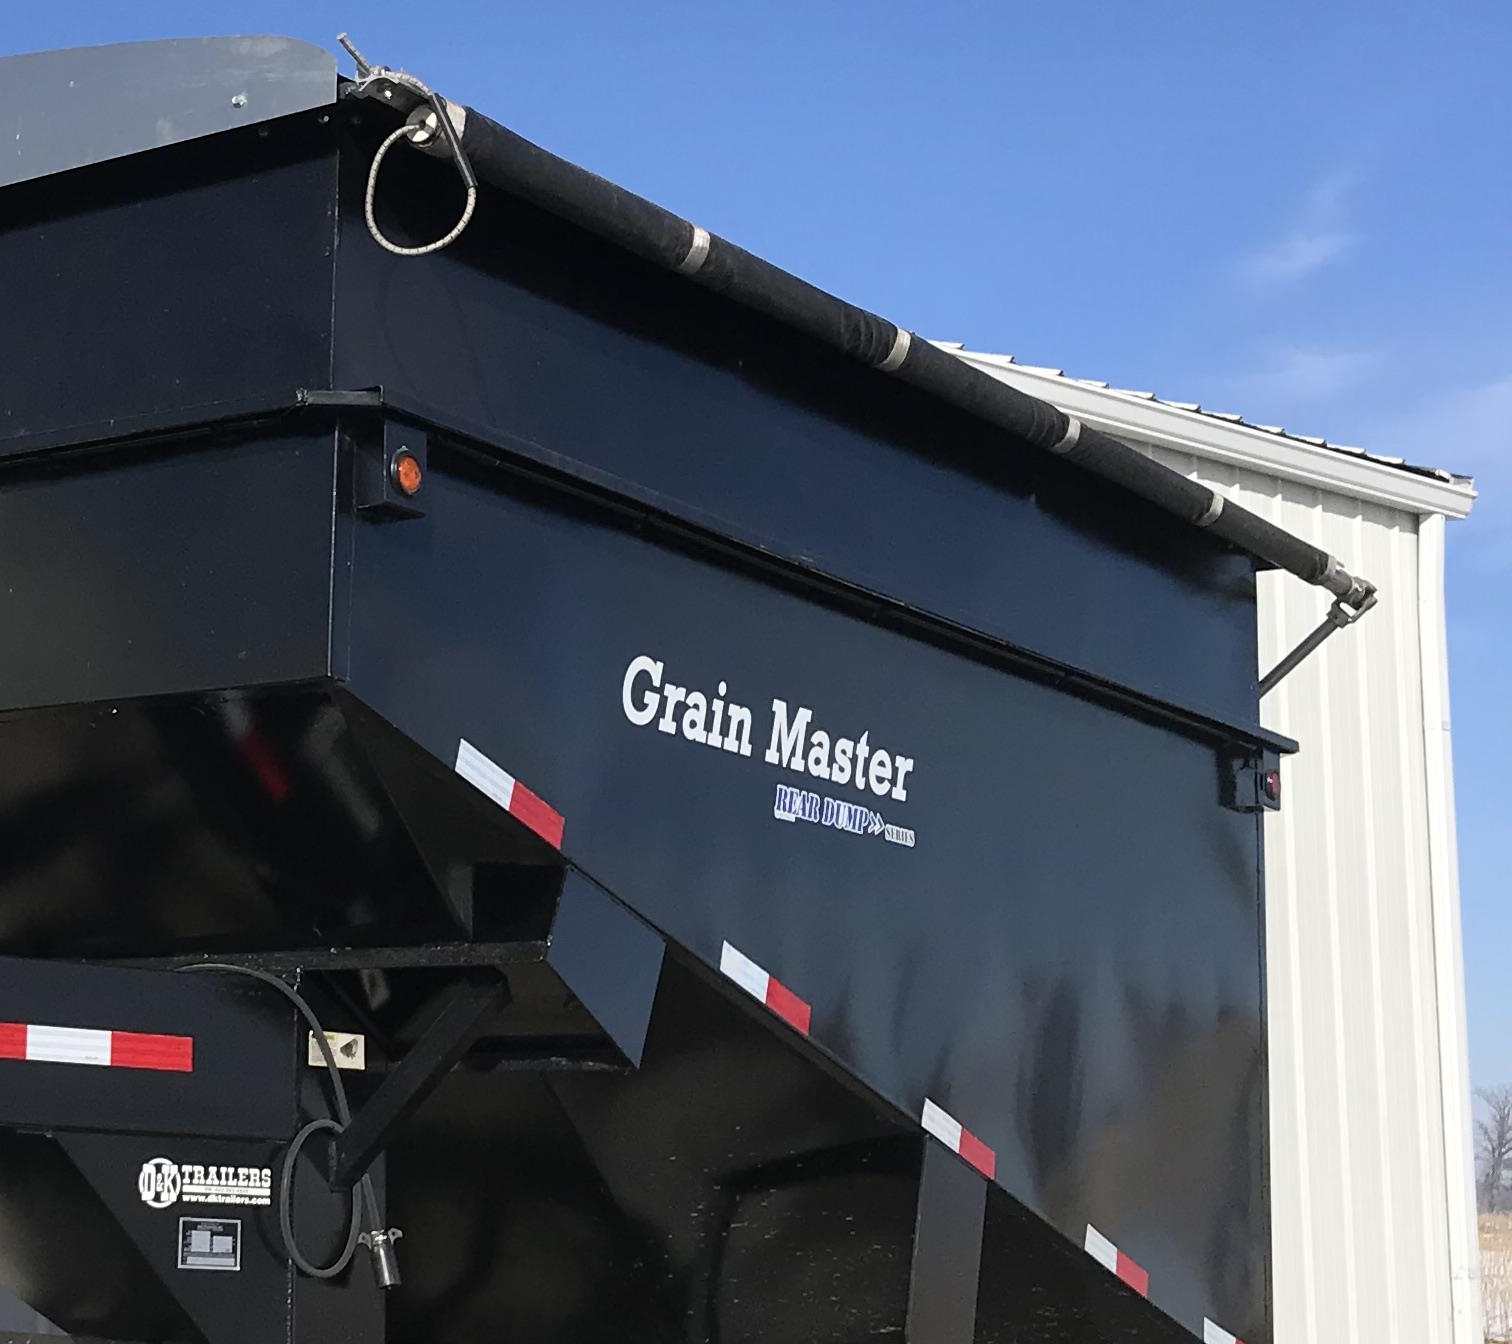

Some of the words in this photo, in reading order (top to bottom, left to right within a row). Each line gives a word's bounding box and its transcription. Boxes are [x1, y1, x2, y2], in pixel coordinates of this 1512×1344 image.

[622, 655, 752, 757] Grain
[765, 698, 914, 802] Master
[775, 784, 821, 823] REAR
[822, 797, 870, 835] DUMP
[886, 826, 915, 844] SERIES
[140, 1162, 179, 1202] D&K
[181, 1164, 272, 1188] TRAILERS
[181, 1193, 271, 1206] www.dktrailers.com
